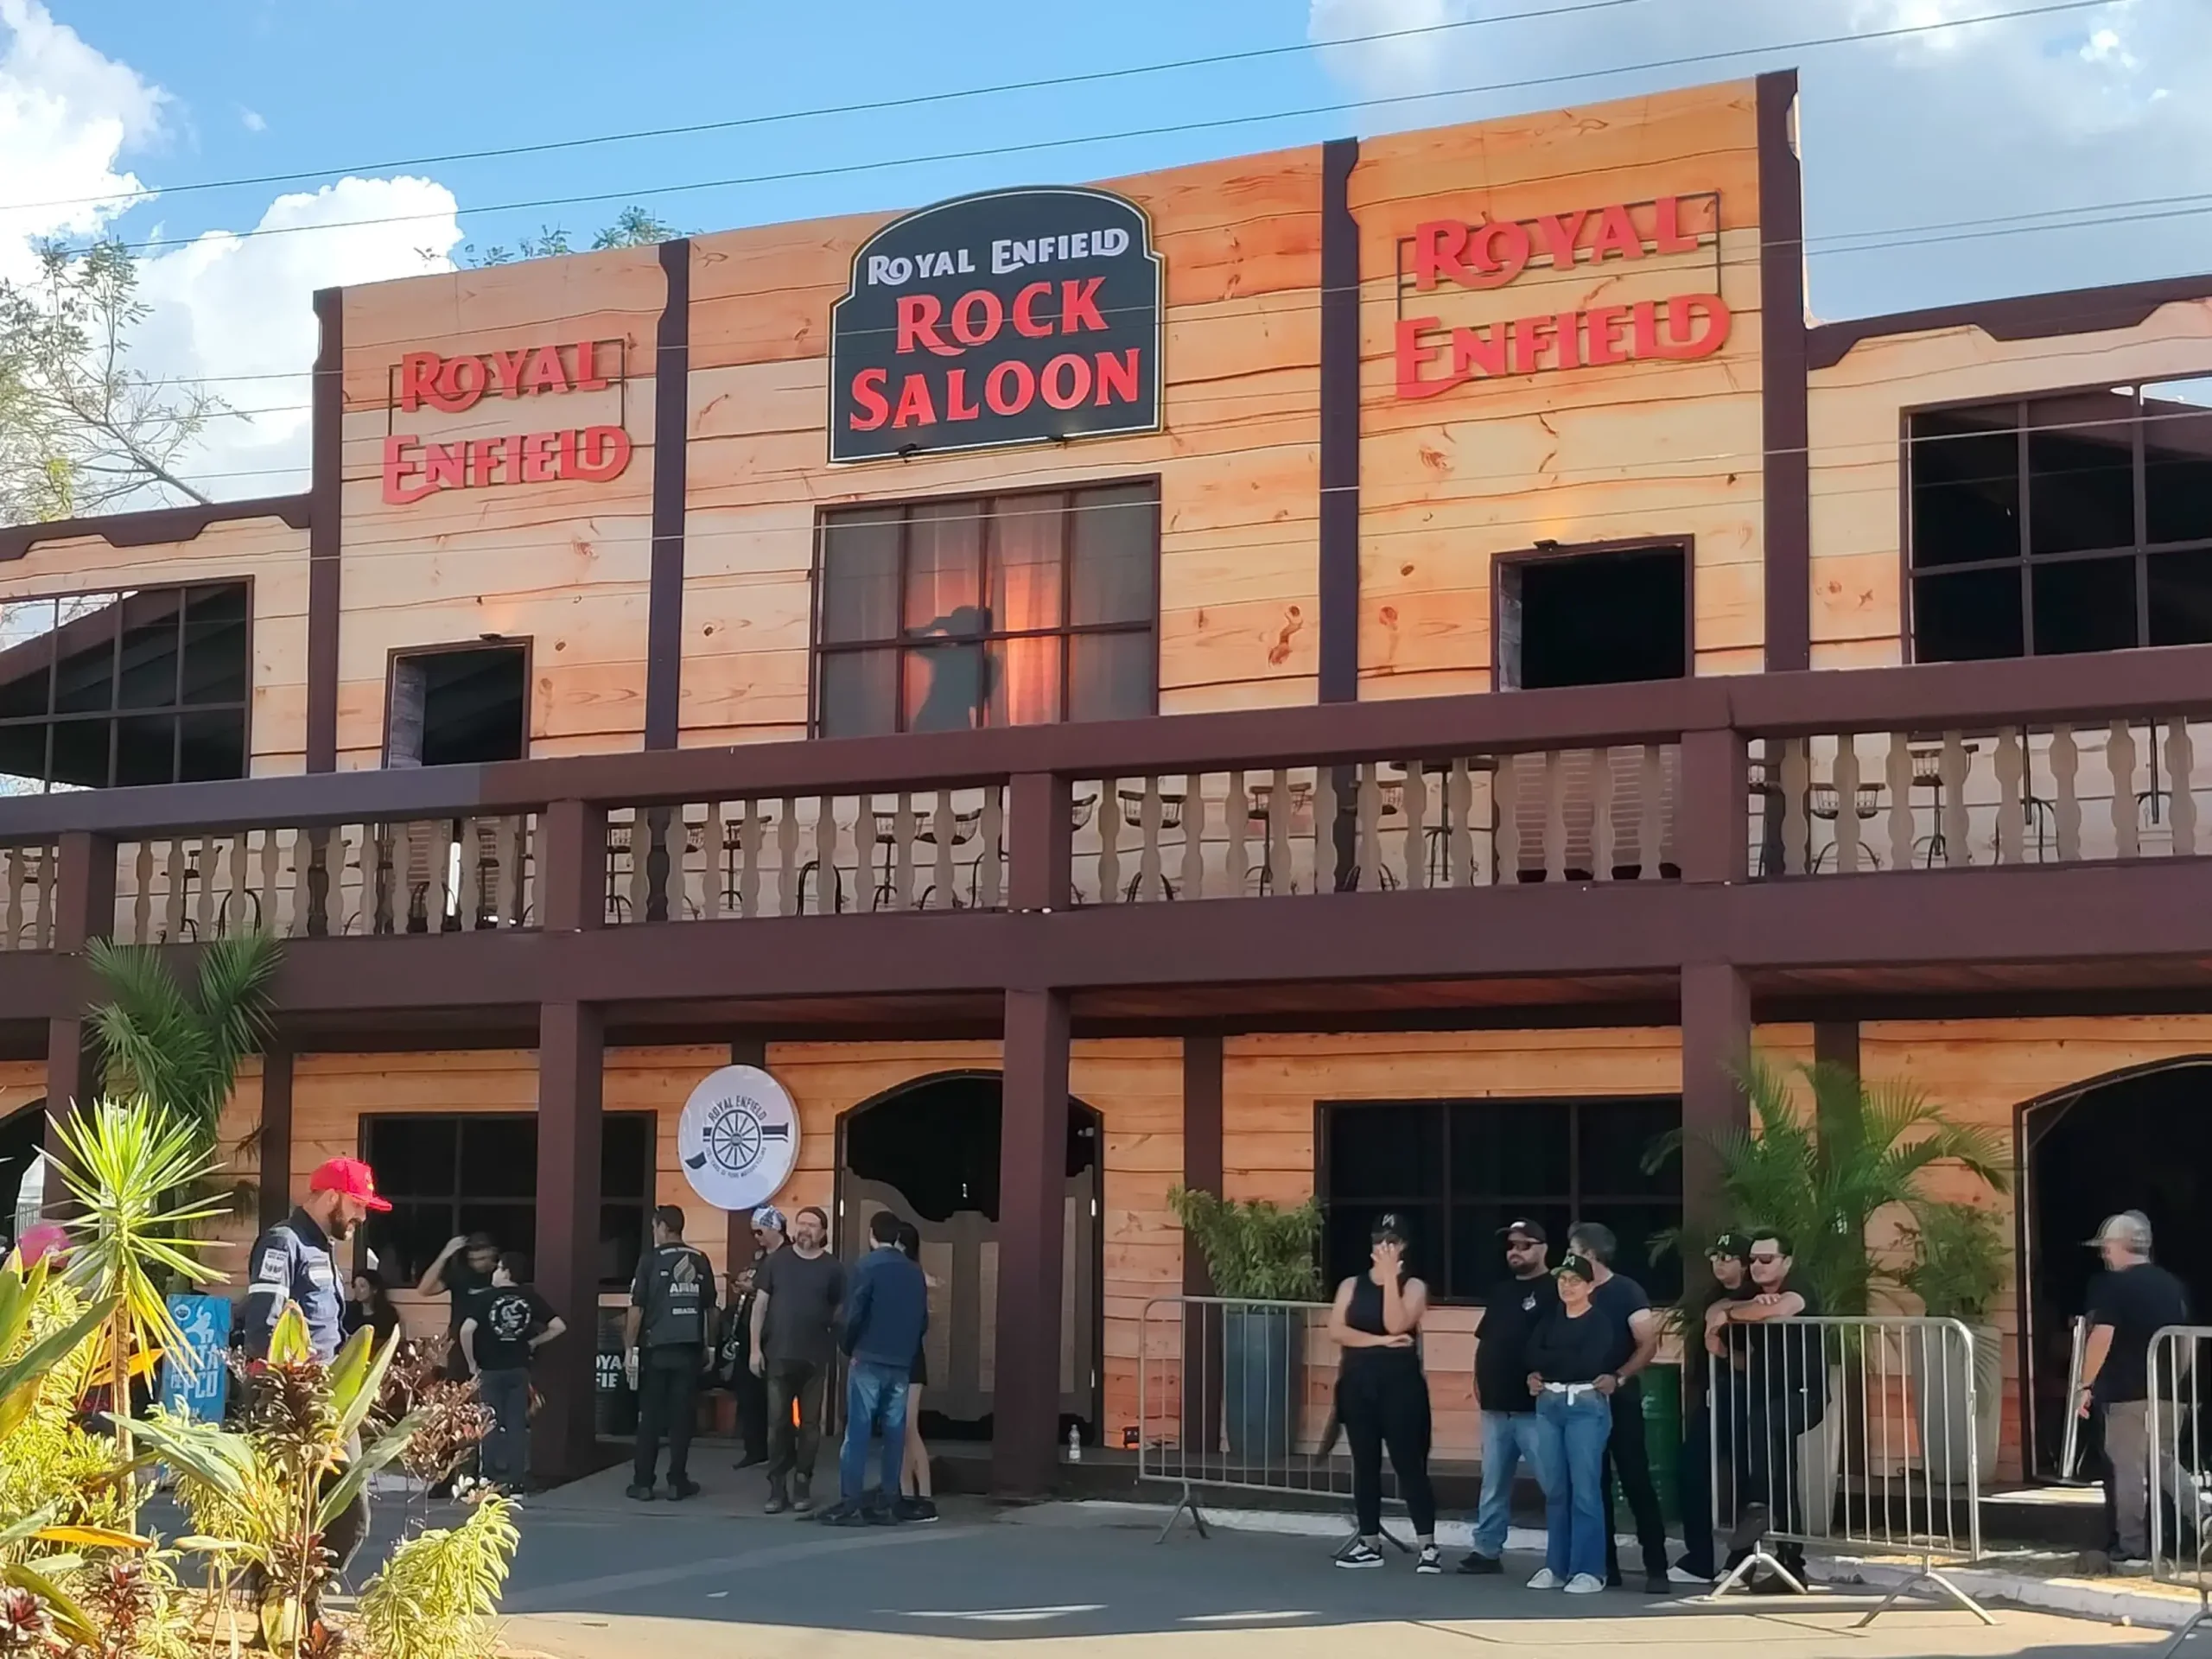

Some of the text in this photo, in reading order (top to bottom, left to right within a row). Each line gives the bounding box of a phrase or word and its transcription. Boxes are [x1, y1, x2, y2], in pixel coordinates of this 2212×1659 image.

[868, 227, 1130, 286] ROYAL ENFIELD
[1415, 196, 1699, 292] ROYAL
[895, 276, 1110, 356] ROCK
[1395, 293, 1731, 400] ENFIELD
[401, 341, 609, 413] ROYAL
[849, 347, 1141, 431] SALOON
[382, 425, 632, 505] ENFIELD
[708, 1095, 767, 1122] ROYAL ENFIELD
